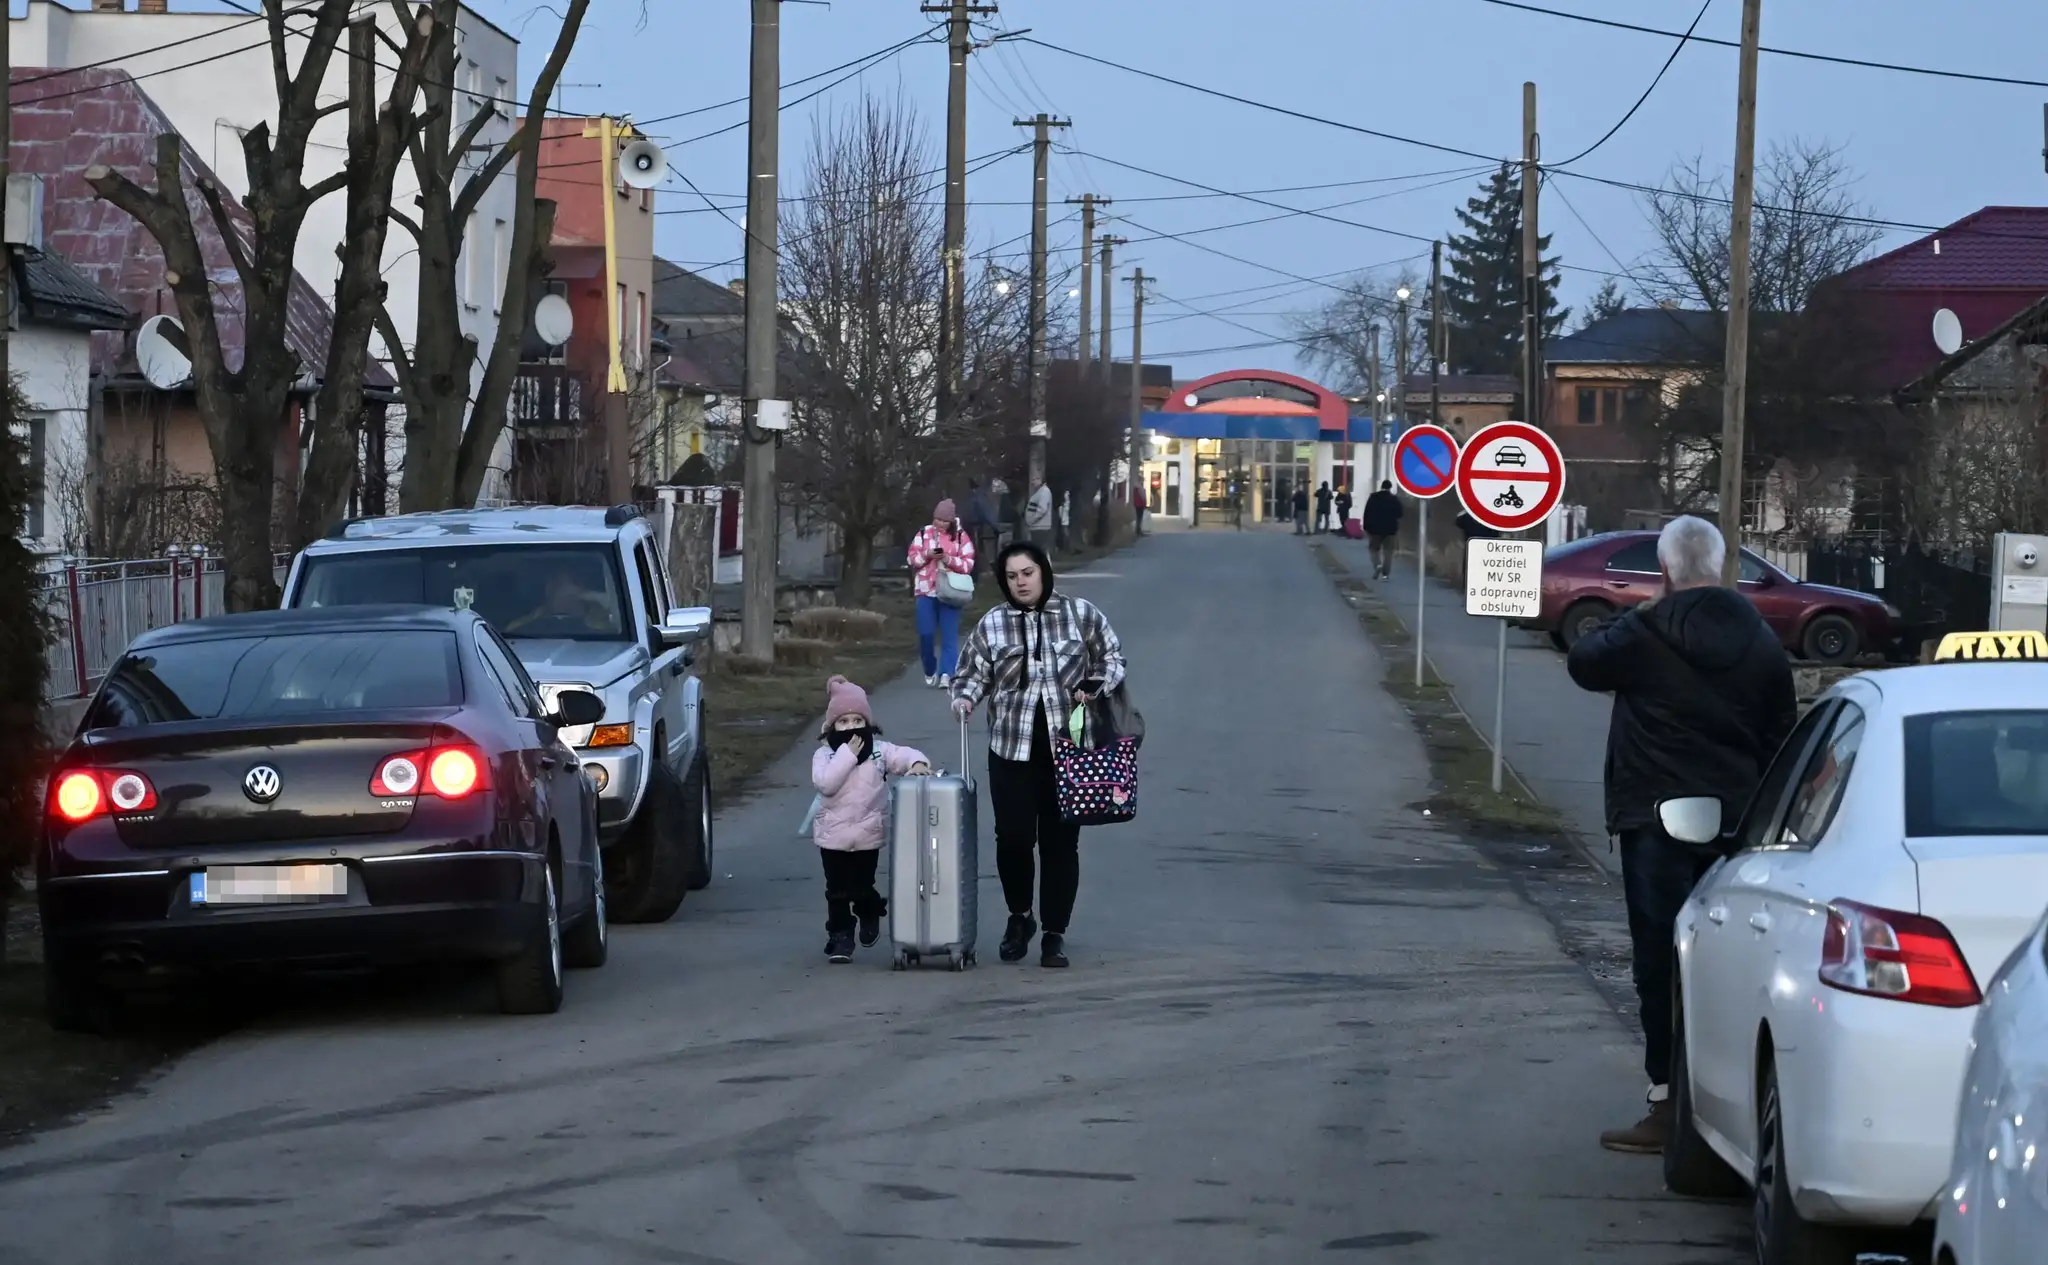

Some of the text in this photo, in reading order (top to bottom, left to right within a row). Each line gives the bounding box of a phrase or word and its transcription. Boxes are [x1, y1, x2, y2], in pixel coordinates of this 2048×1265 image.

[1487, 542, 1523, 553] Okrem
[1483, 557, 1526, 568] vozidiel
[1487, 572, 1521, 583] MV SR
[1469, 586, 1537, 601] a dopravnej
[1480, 602, 1525, 615] obsluhy
[1955, 636, 2034, 659] TAXI
